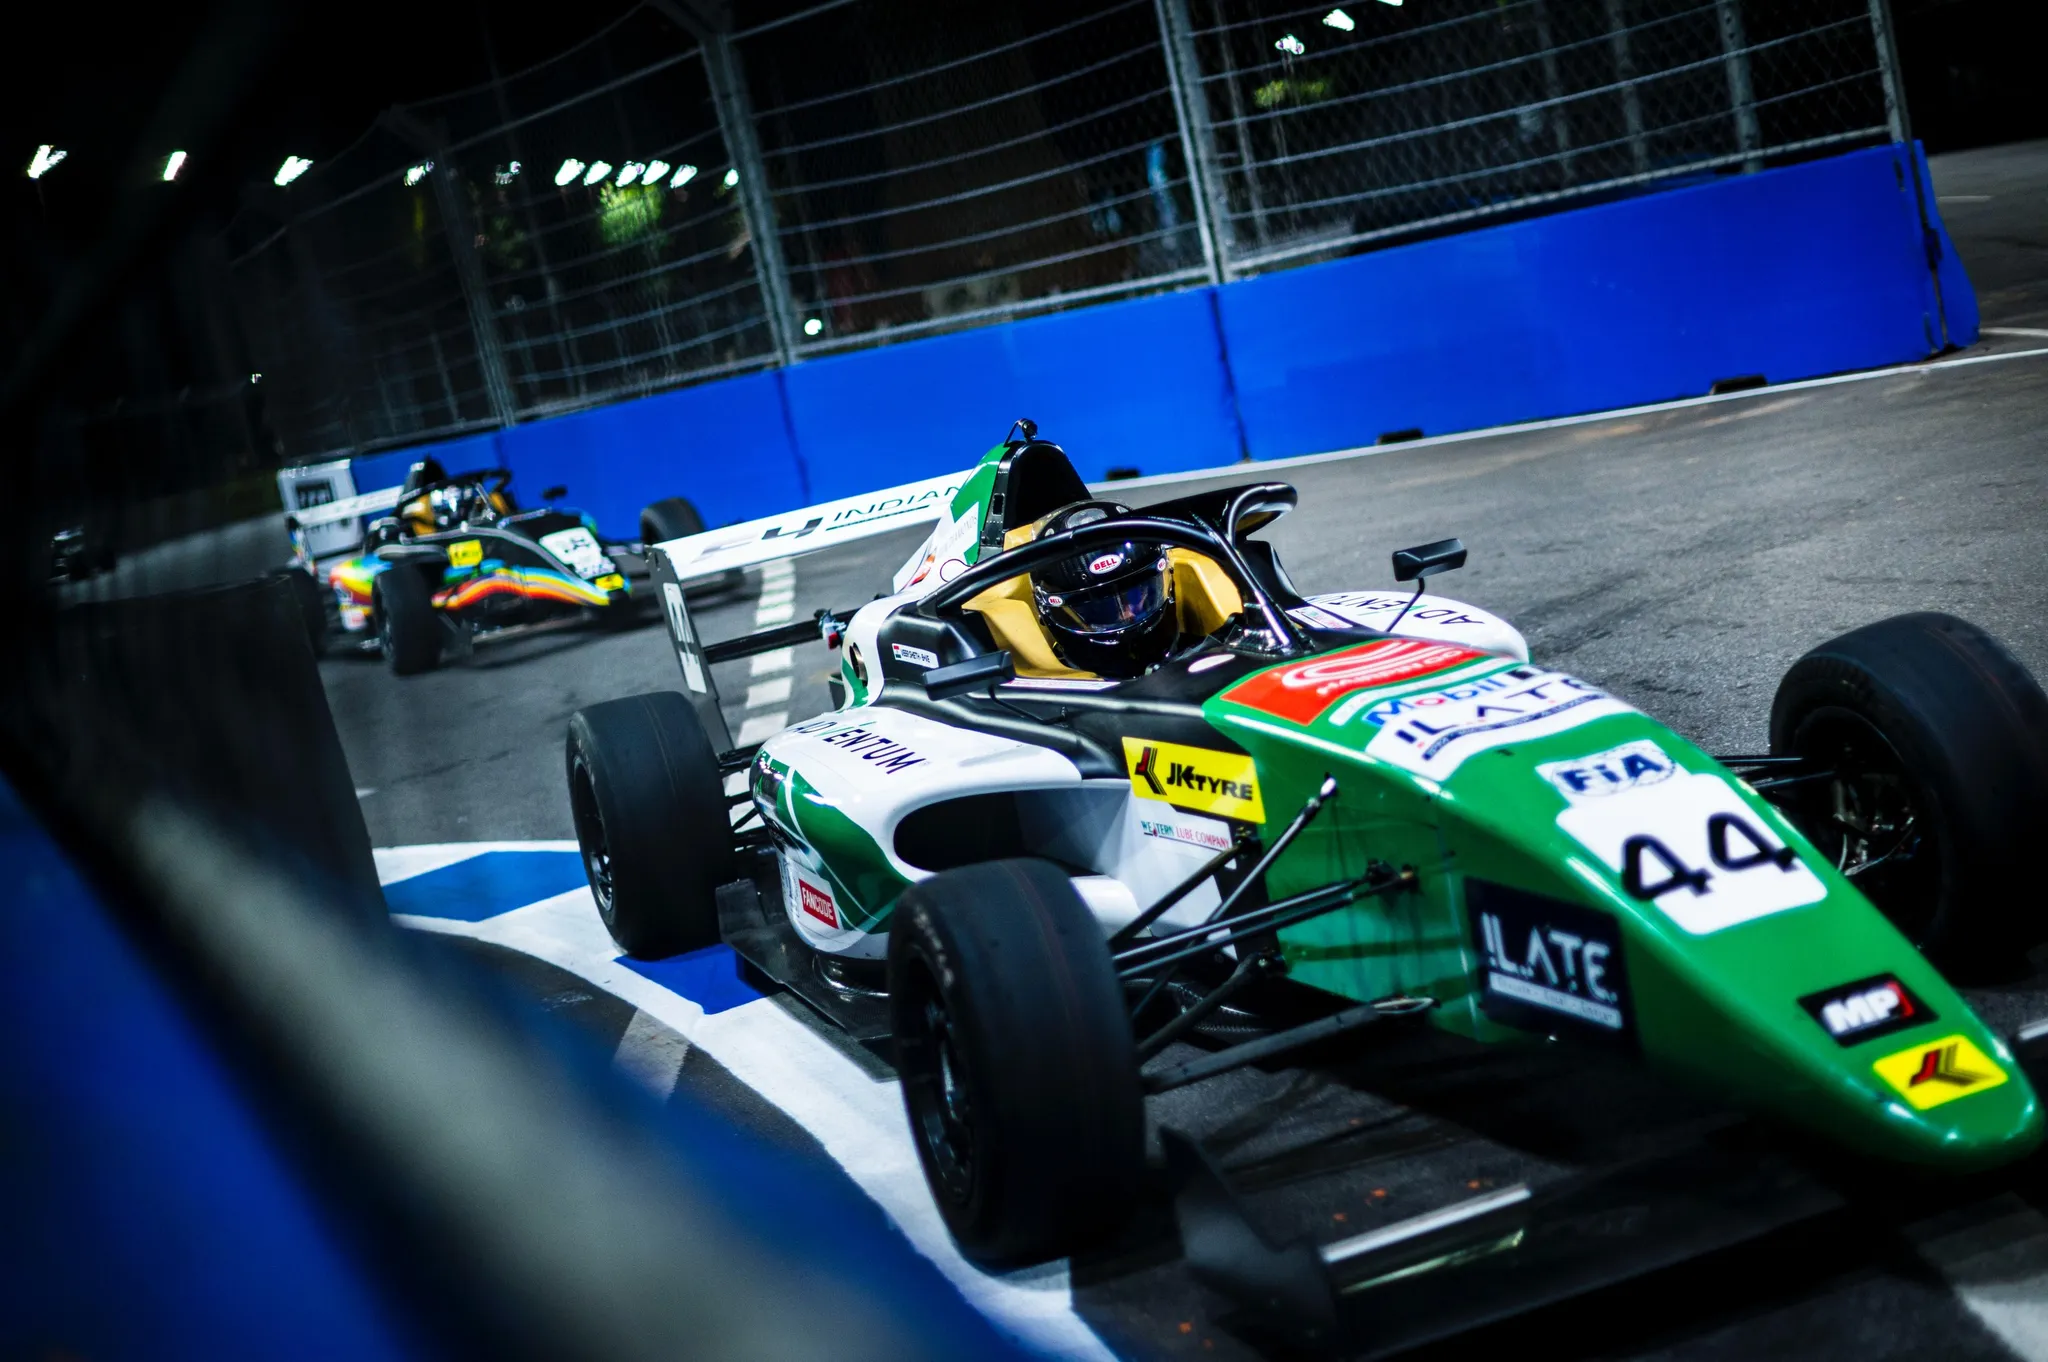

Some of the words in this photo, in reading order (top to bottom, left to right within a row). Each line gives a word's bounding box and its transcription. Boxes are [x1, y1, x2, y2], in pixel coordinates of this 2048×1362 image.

[1093, 557, 1117, 571] BELL
[1175, 826, 1194, 839] LUBE
[1621, 812, 1801, 901] 44
[801, 886, 835, 921] FANCODE
